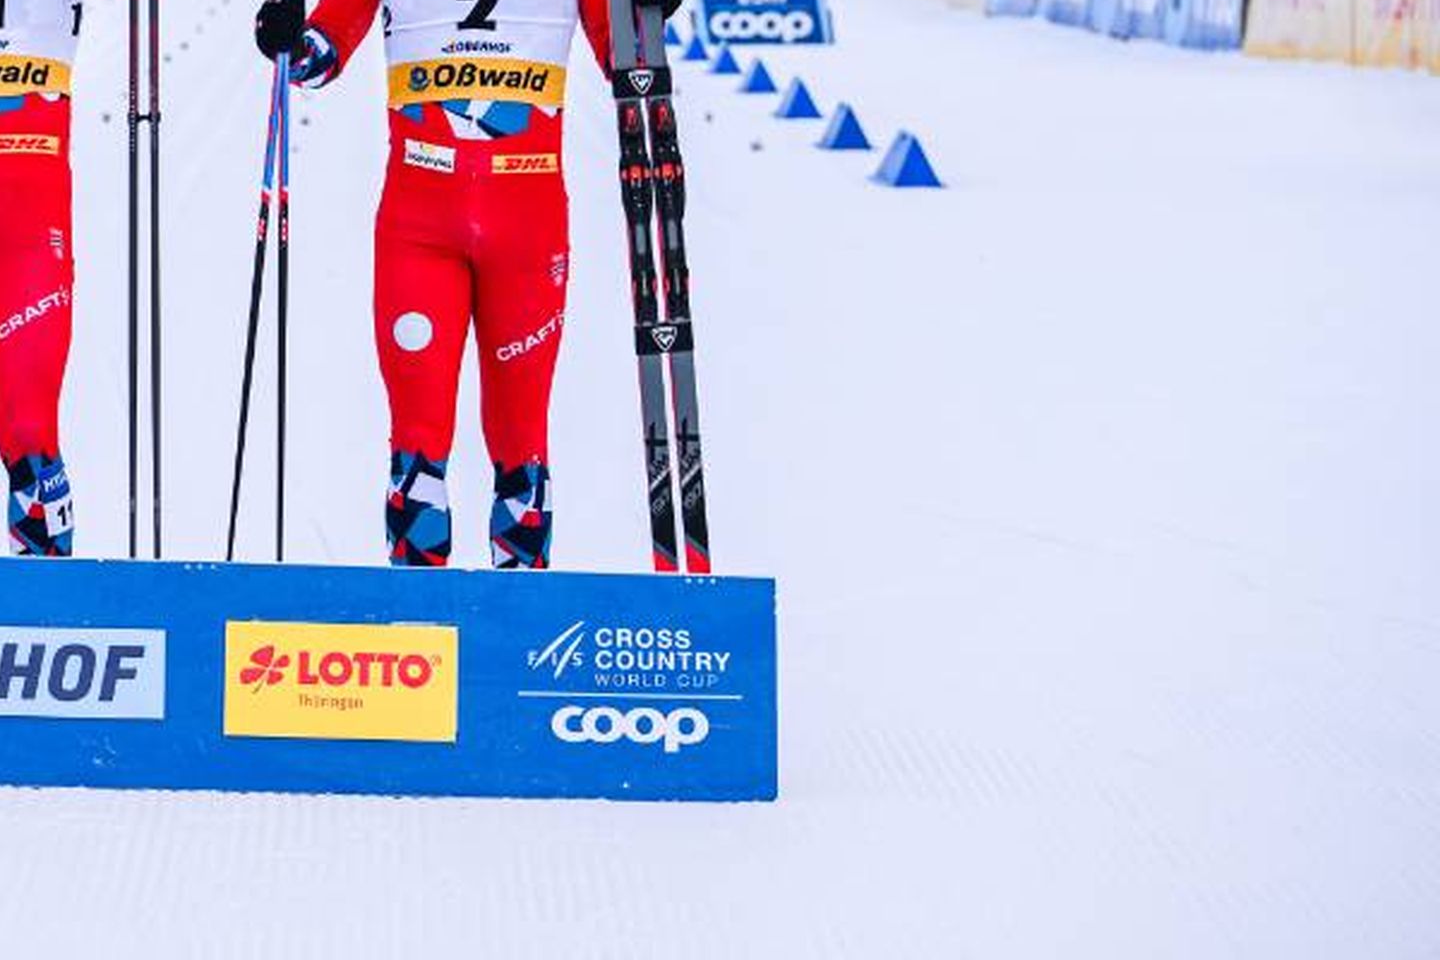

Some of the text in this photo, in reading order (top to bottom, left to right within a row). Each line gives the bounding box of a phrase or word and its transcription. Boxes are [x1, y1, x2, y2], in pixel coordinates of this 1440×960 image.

[710, 11, 815, 43] coop
[504, 157, 551, 170] DHL
[496, 316, 562, 361] CRAFT
[594, 628, 691, 649] CROSS
[297, 650, 433, 689] LOTTO
[594, 650, 731, 672] COUNTRY
[594, 673, 720, 688] WORLD CUP
[551, 705, 710, 753] coop
